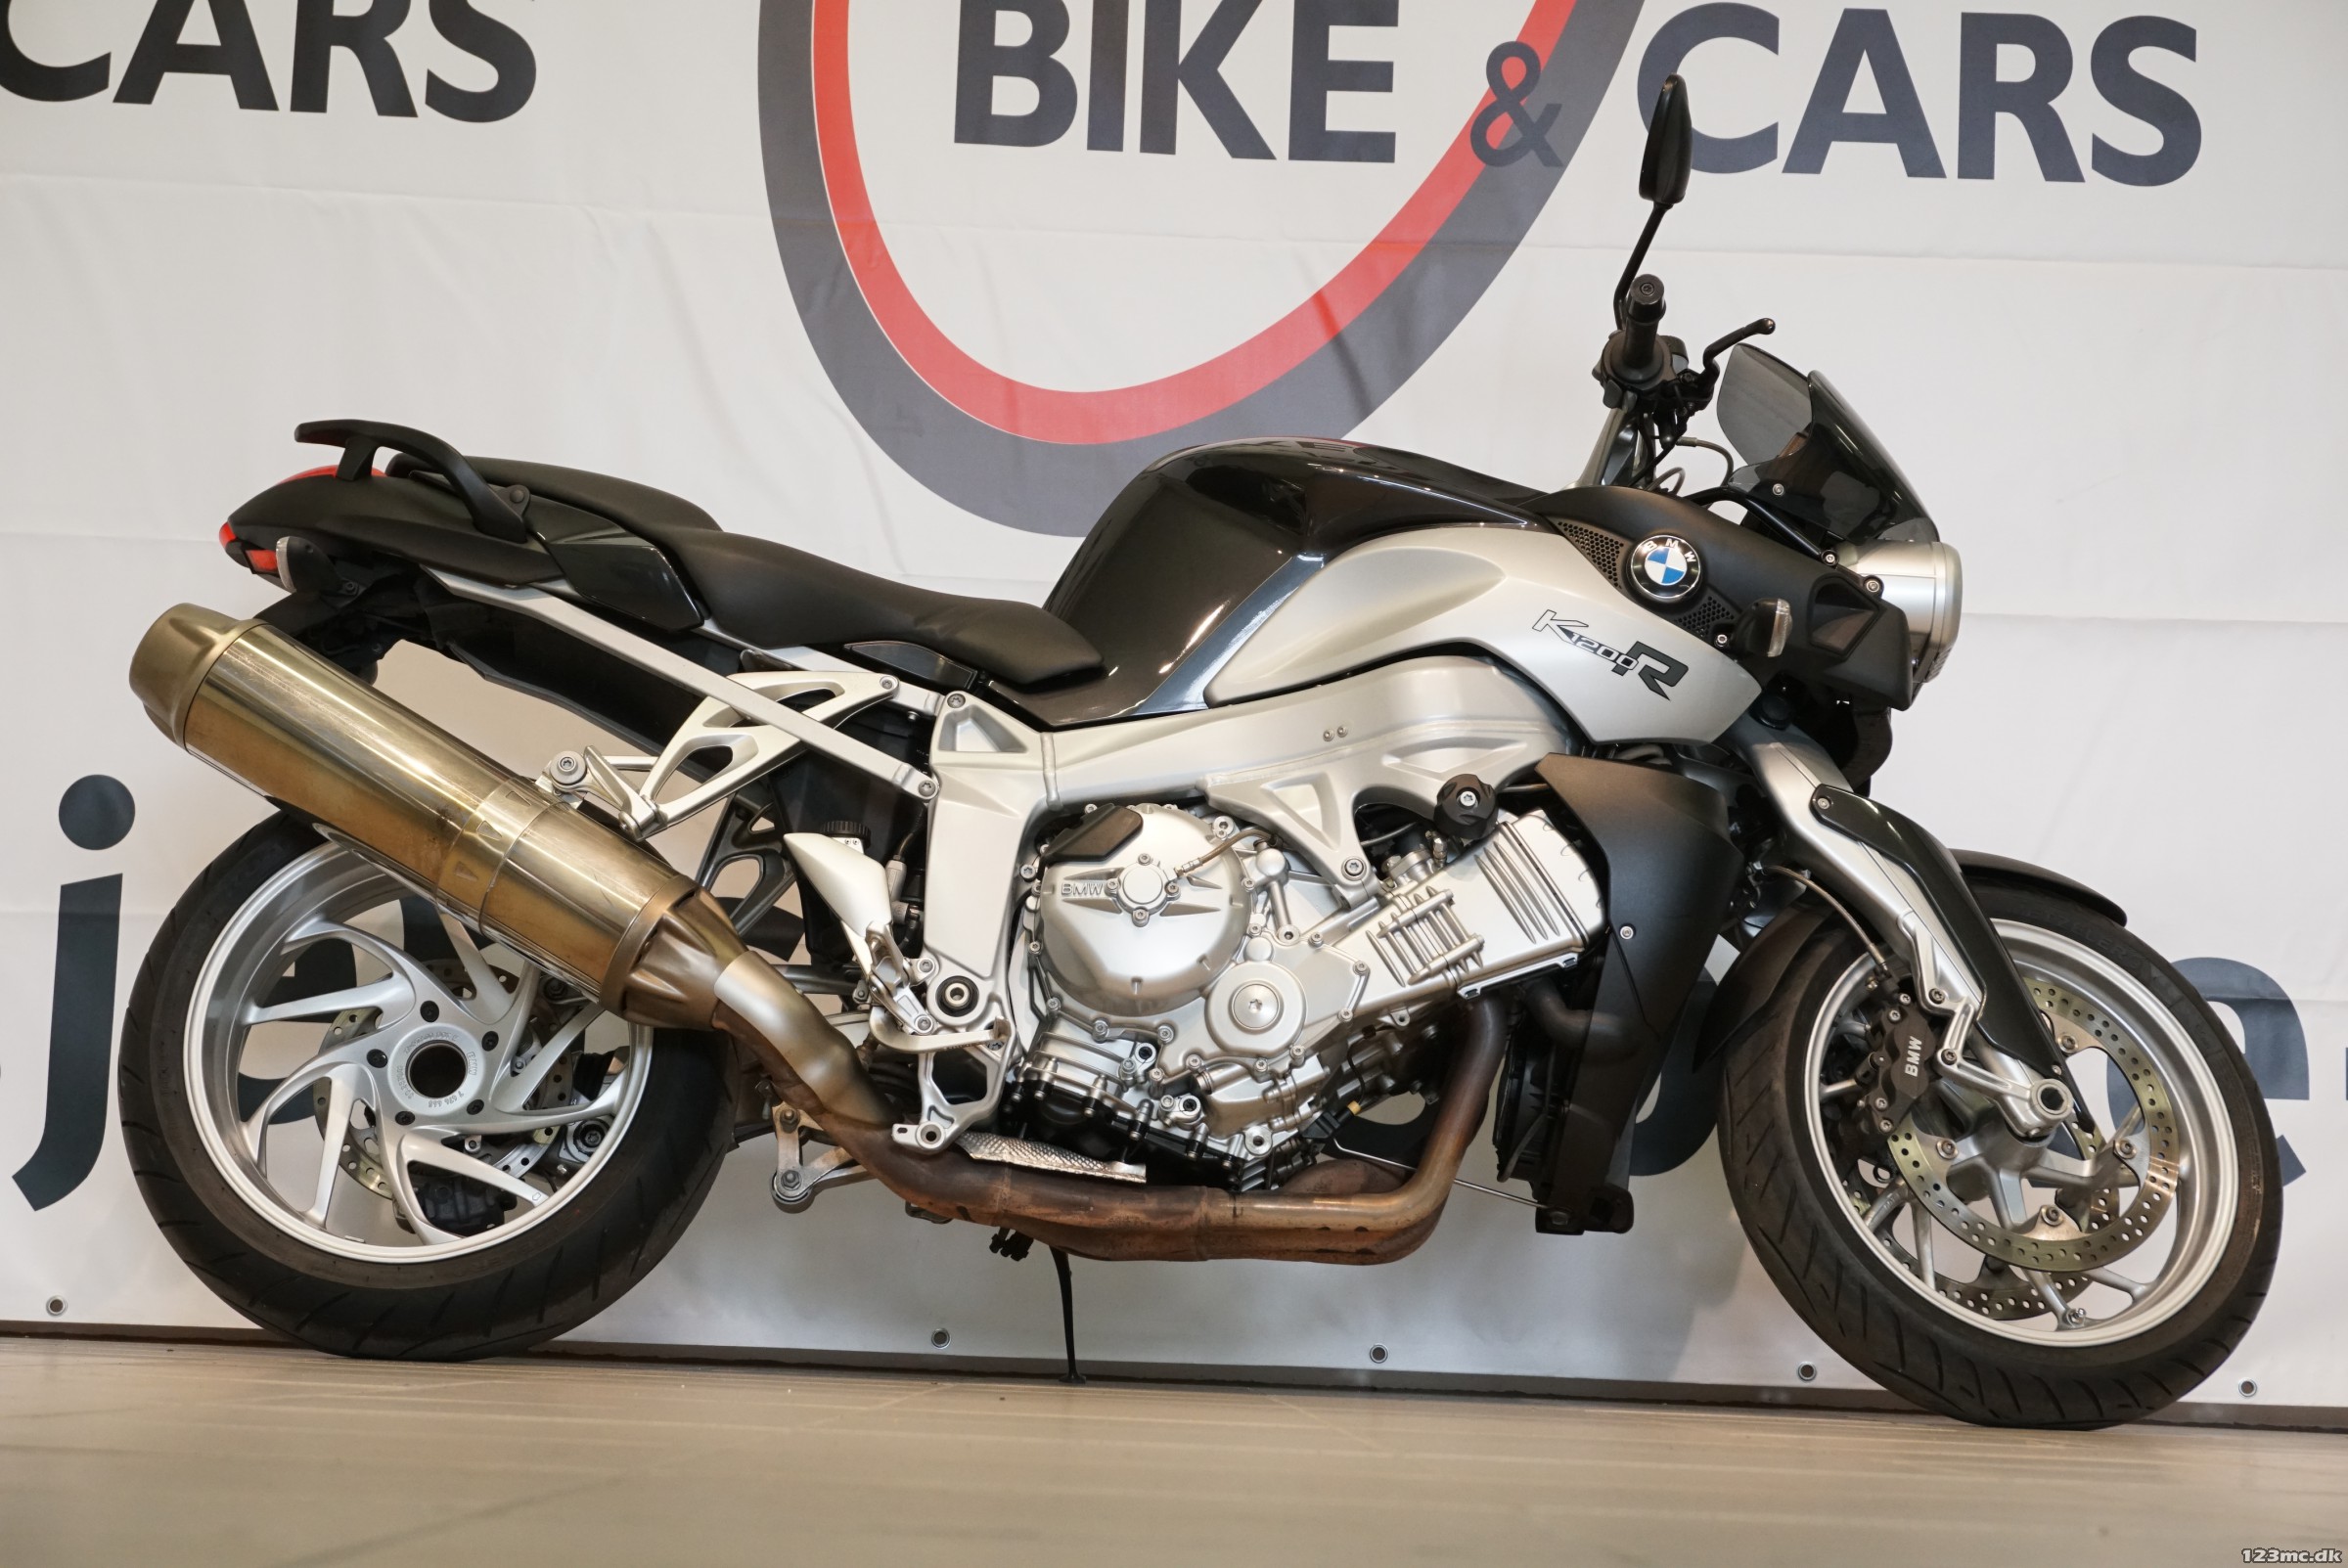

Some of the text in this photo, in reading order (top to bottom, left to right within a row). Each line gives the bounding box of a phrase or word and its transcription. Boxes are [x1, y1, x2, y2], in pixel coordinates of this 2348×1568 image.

[953, 0, 2202, 187] BIKE & CARS
[1641, 538, 1696, 563] BMW
[1061, 882, 1104, 896] BMW
[1905, 1036, 1922, 1077] BMW
